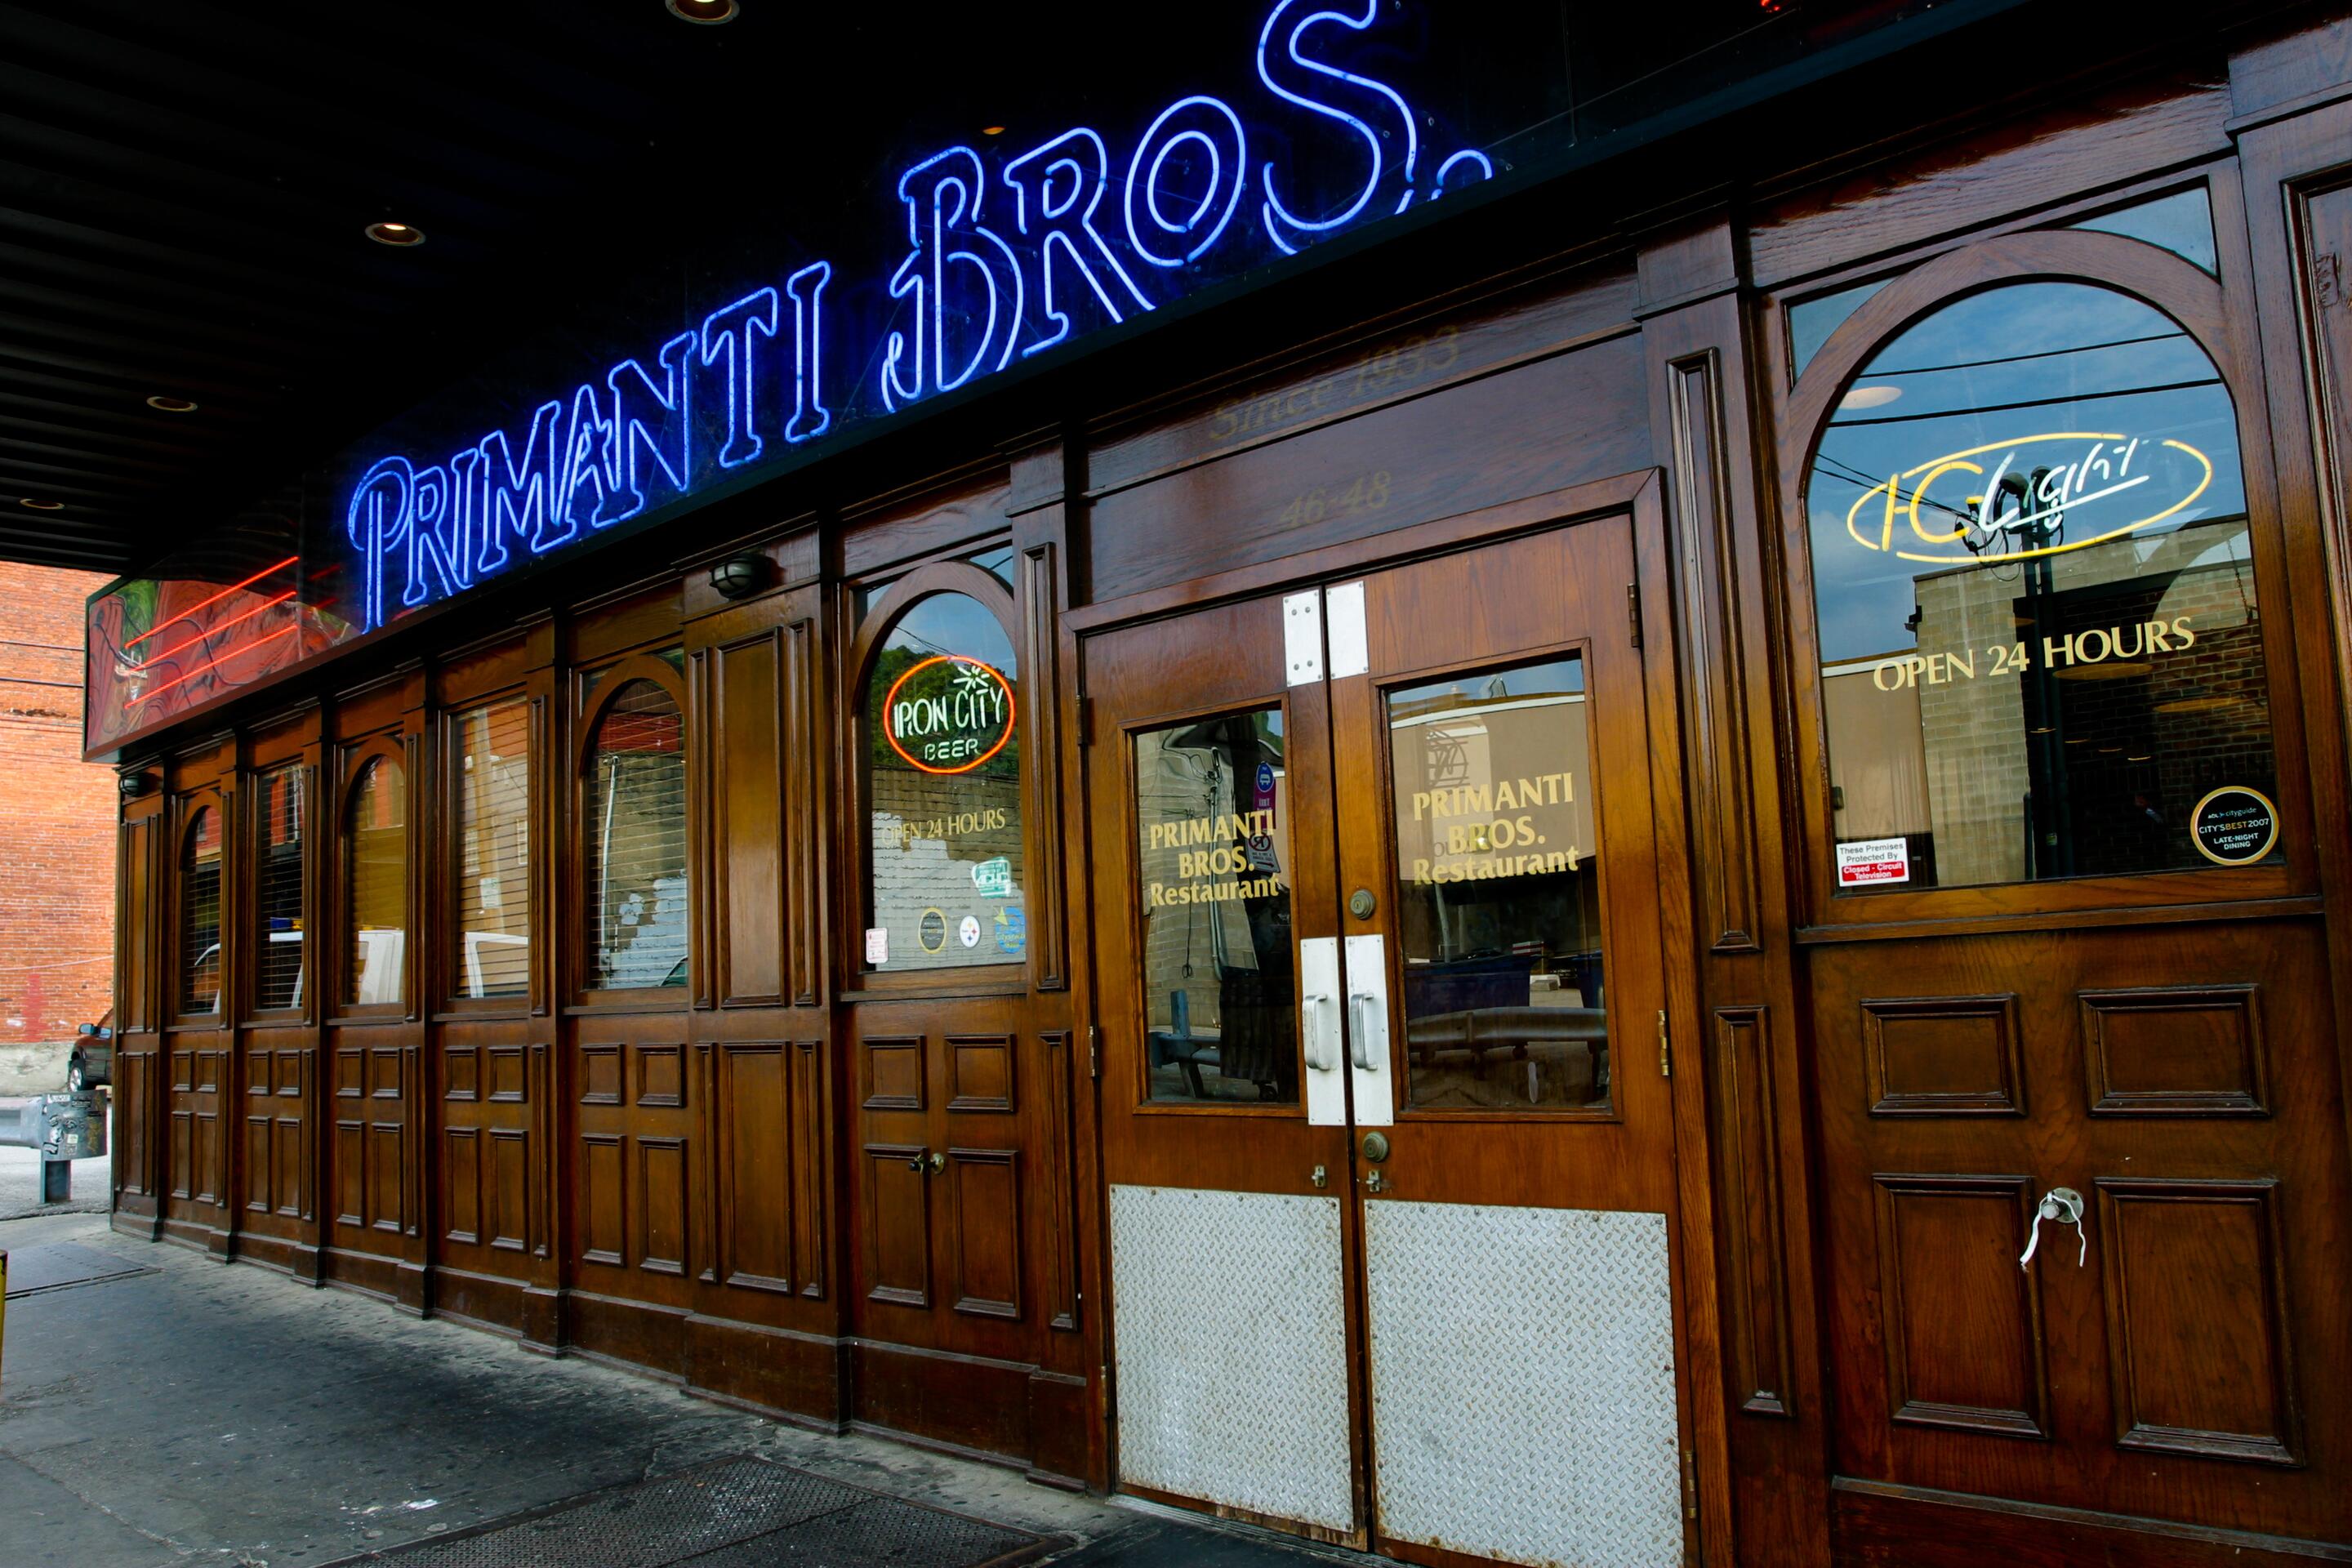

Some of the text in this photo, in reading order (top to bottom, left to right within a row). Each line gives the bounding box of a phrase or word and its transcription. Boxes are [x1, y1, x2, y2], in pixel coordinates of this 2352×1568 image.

[1209, 325, 1461, 441] Since 1933
[347, 259, 833, 636] PRIMANTI
[1278, 470, 1392, 529] 46-48
[1873, 616, 2196, 693] OPEN 24 HOURS
[893, 687, 1004, 739] IRON CITY
[924, 737, 982, 761] BEER
[1412, 772, 1574, 821] PRIMANTI
[881, 807, 1006, 846] OPEN 24 HOURS
[1149, 809, 1276, 850] PRIMANTI
[1448, 815, 1547, 855] BROS.
[2213, 832, 2259, 844] LATE-NIGHT
[2224, 840, 2251, 850] DINING
[1178, 845, 1255, 880] BROS.
[1413, 845, 1580, 886] Restaurant
[1840, 843, 1904, 855] These Premises
[1843, 864, 1870, 874] Closed
[1877, 862, 1903, 871] Circuit
[1846, 852, 1899, 863] Protected By
[1150, 872, 1280, 907] Restaurant
[1855, 871, 1892, 880] Television
